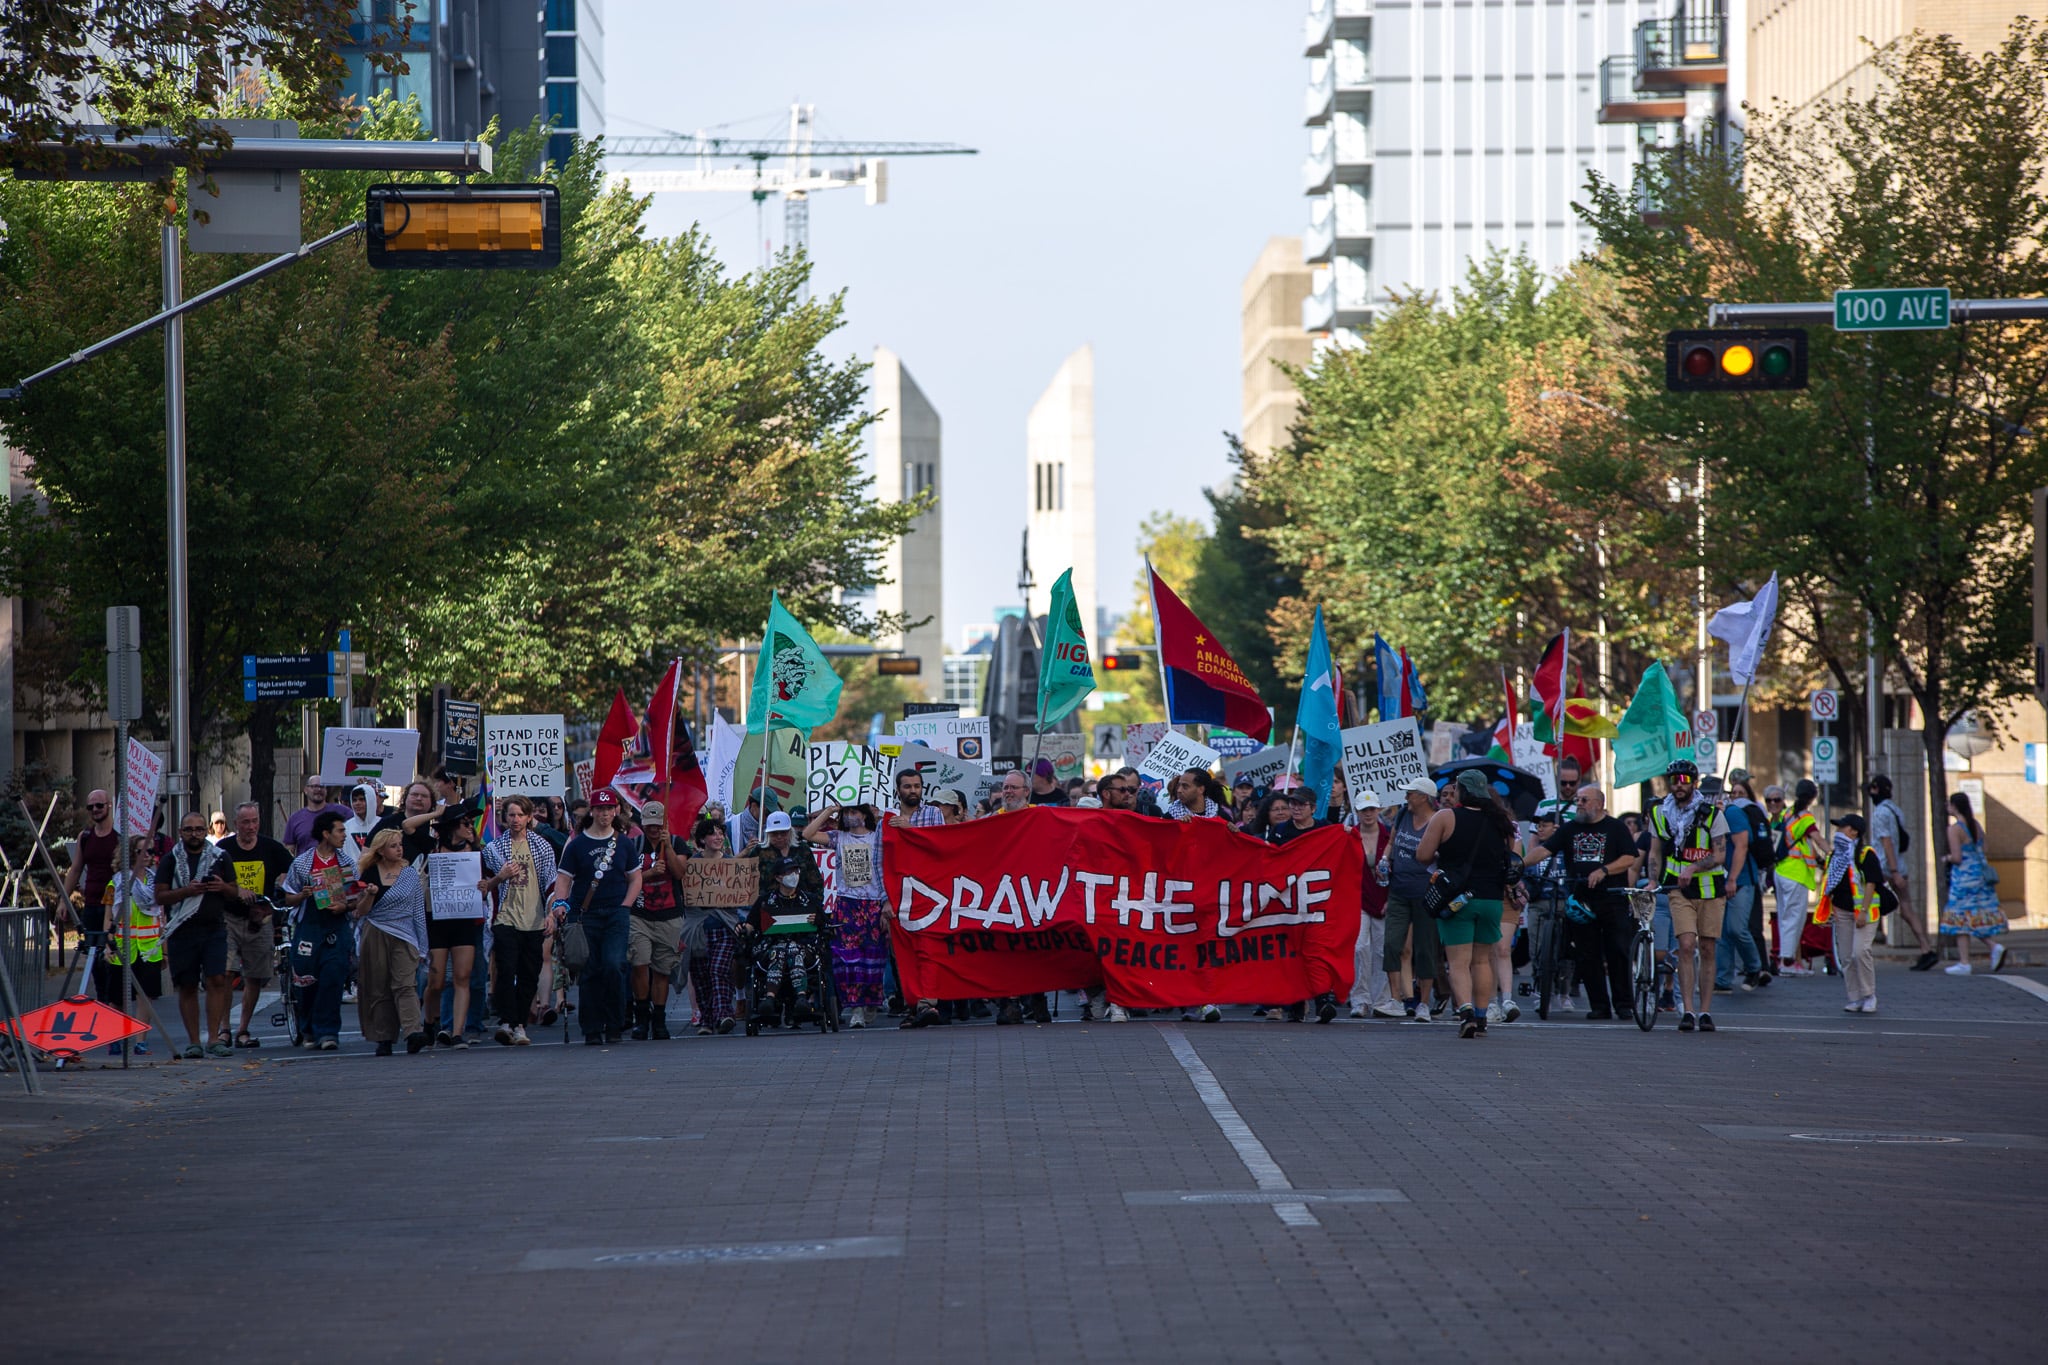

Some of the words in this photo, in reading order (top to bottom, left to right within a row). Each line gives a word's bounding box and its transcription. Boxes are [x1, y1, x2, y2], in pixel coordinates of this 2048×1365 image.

[1842, 297, 1886, 322] 100
[1898, 296, 1943, 321] AVE
[282, 656, 295, 664] Park
[1197, 649, 1243, 676] ANAKBA
[1197, 661, 1255, 691] EDMONTO
[287, 680, 306, 688] Bridge
[447, 717, 478, 740] VS
[489, 729, 533, 740] STAND
[538, 728, 559, 739] FOR
[896, 723, 937, 736] SYSTEM
[946, 721, 989, 735] CLIMATE
[336, 734, 362, 748] Stop
[374, 736, 391, 747] the
[446, 736, 457, 744] ALL
[1209, 737, 1259, 748] PROTECT
[129, 740, 142, 761] YOU
[143, 751, 159, 775] HAVE
[345, 747, 394, 759] Genocide
[494, 743, 558, 757] JUSTICE
[1158, 740, 1189, 761] FUND
[1189, 755, 1212, 771] OUR
[1220, 746, 1252, 755] WATER
[1344, 740, 1391, 761] FULL
[513, 760, 536, 769] AND
[810, 744, 898, 776] PLANET
[994, 761, 1015, 770] END
[1150, 750, 1187, 772] FAMILIES
[1347, 752, 1418, 774] IMMIGRATION
[1144, 759, 1178, 780] COMMUN
[1236, 760, 1285, 778] ENIORS
[1351, 767, 1397, 786] STATUS
[1401, 762, 1423, 776] FOR
[127, 771, 146, 792] OMMON
[143, 771, 151, 783] IN
[500, 774, 549, 787] PEACE
[808, 766, 890, 793] OVER
[808, 784, 892, 814] PROFIT
[1684, 848, 1711, 860] LIAISO
[240, 864, 255, 872] THE
[686, 862, 703, 875] OU
[240, 872, 257, 880] WAR
[433, 889, 455, 901] RESIST
[457, 888, 475, 900] EVERY
[685, 892, 713, 905] EAT
[715, 890, 755, 906] MONEY
[898, 864, 1069, 932] DRAW
[1075, 871, 1198, 934] THE
[1216, 869, 1332, 938] LINE
[434, 902, 456, 913] DAMN
[458, 901, 475, 912] DAY
[944, 930, 998, 956] FOR
[1006, 929, 1093, 953] PEOPLE
[1097, 936, 1187, 970] PEACE.
[1197, 933, 1297, 969] PLANET.
